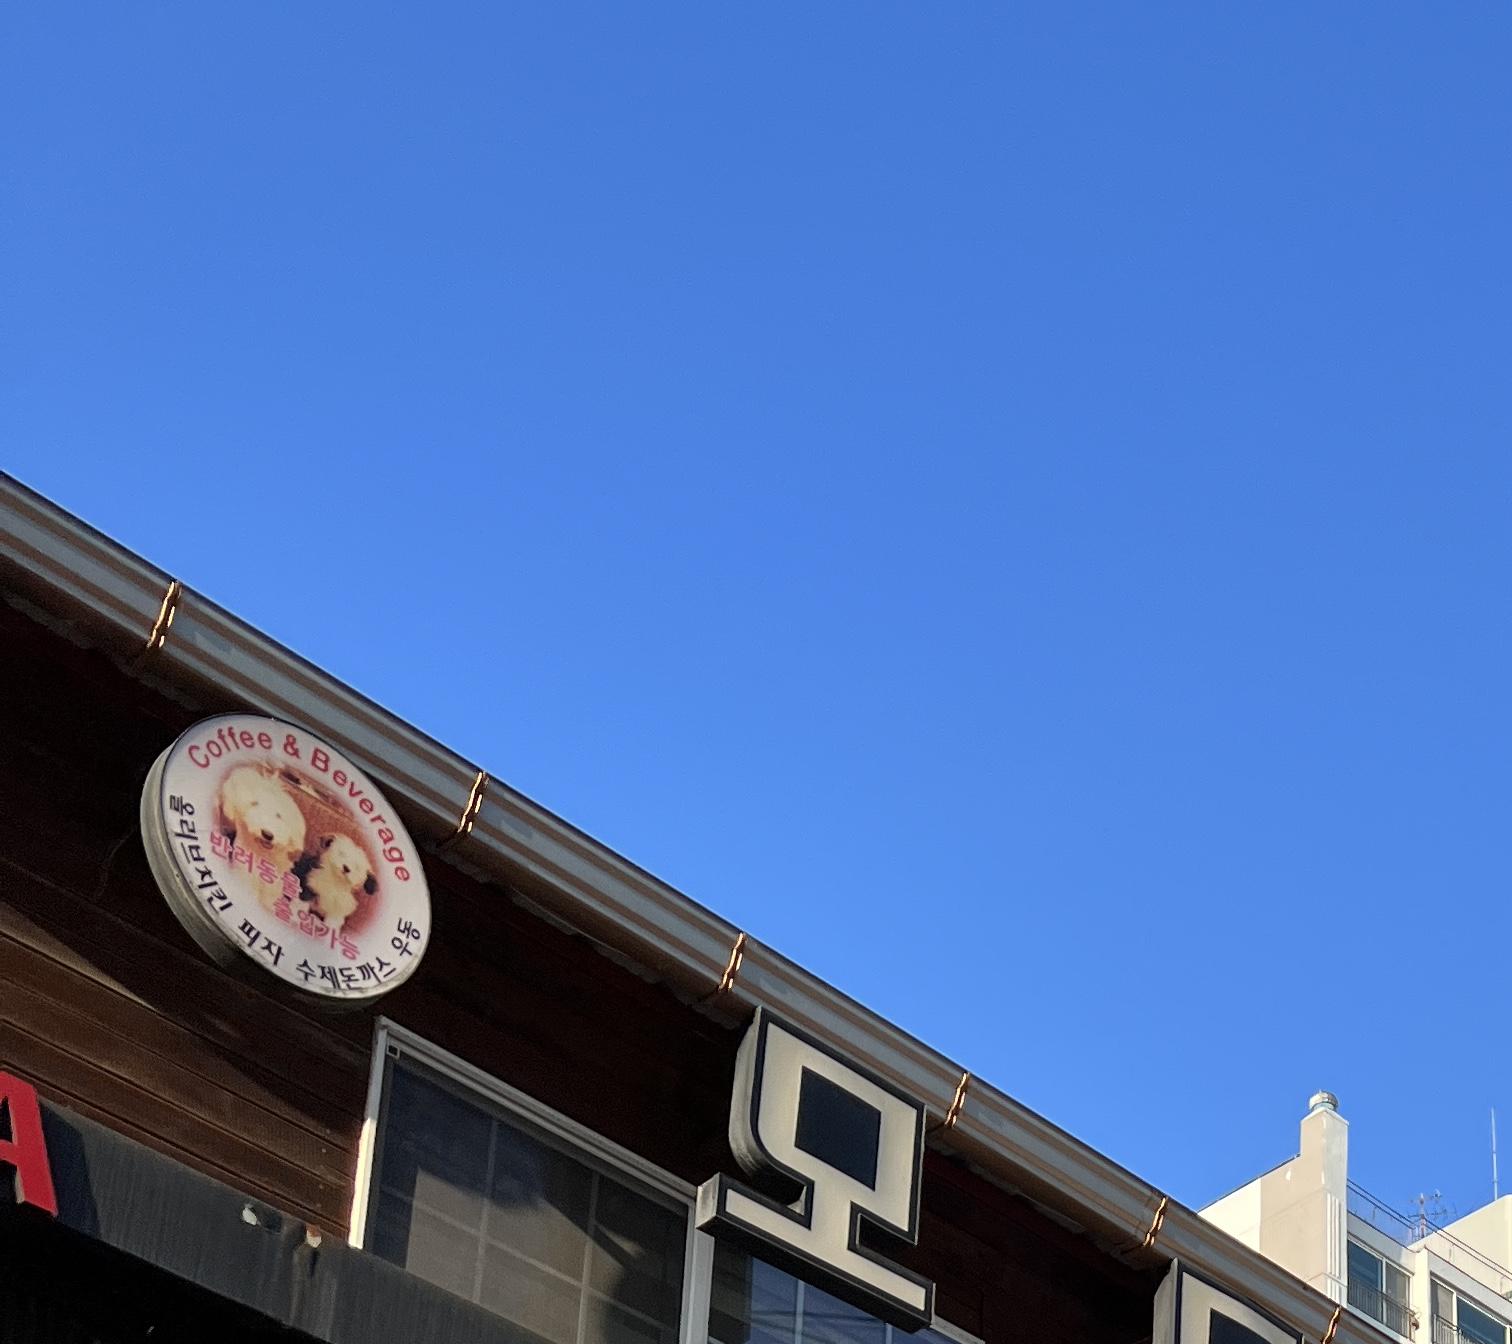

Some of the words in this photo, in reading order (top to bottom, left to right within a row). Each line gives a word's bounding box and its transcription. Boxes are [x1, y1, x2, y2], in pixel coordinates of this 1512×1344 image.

[188, 726, 272, 768] Coffee
[283, 734, 301, 759] &
[311, 748, 410, 882] Beverage
[209, 830, 302, 900] 반려동물
[238, 918, 285, 966] 피자
[296, 957, 397, 991] 수제돈까스
[273, 896, 360, 961] 출입가능
